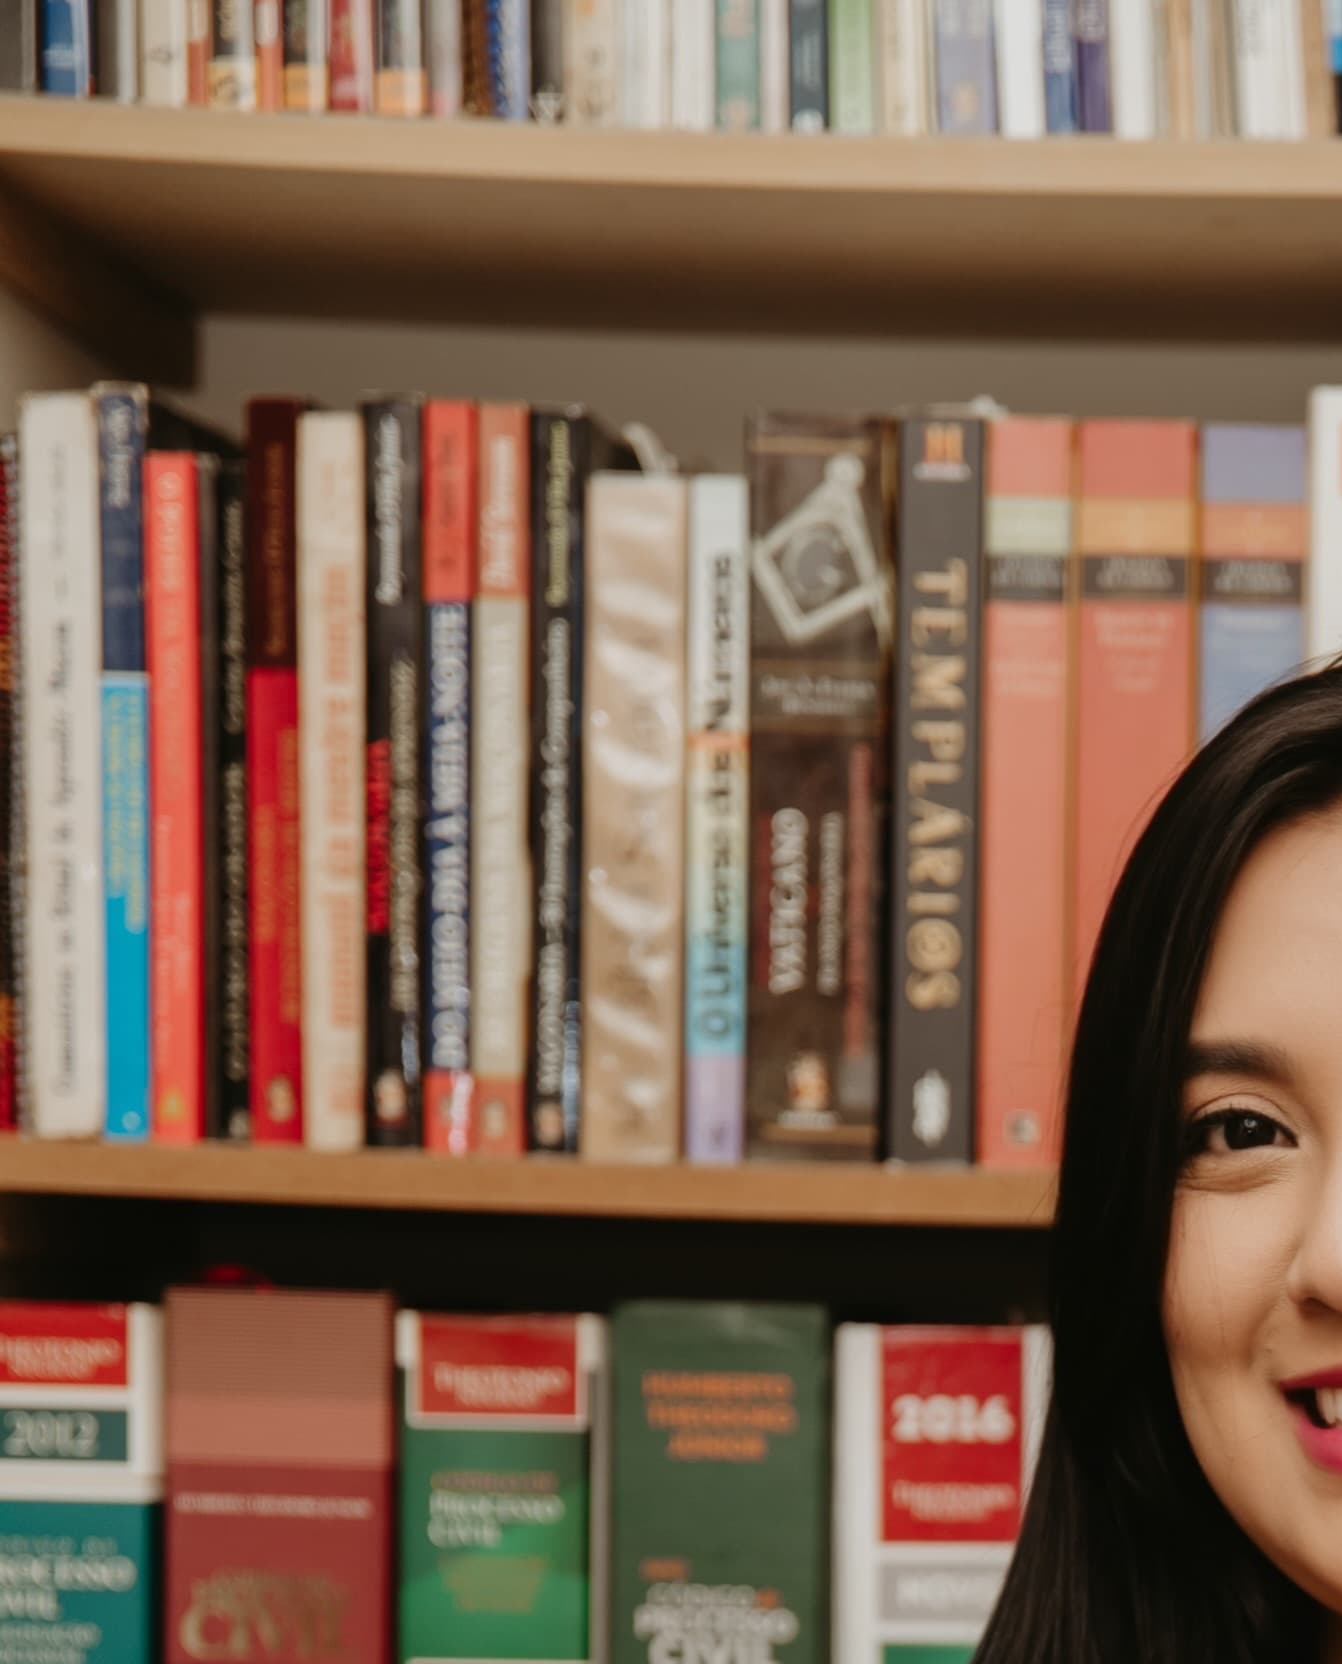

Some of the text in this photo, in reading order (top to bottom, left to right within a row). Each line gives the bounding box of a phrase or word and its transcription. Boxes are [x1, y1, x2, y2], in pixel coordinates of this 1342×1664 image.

[699, 751, 736, 817] dos
[908, 557, 972, 1010] TEMPLÁRIOS
[698, 827, 736, 1000] Universo
[767, 806, 810, 996] VATICANO
[4, 1411, 99, 1457] 2012
[891, 1394, 1014, 1444] 2016
